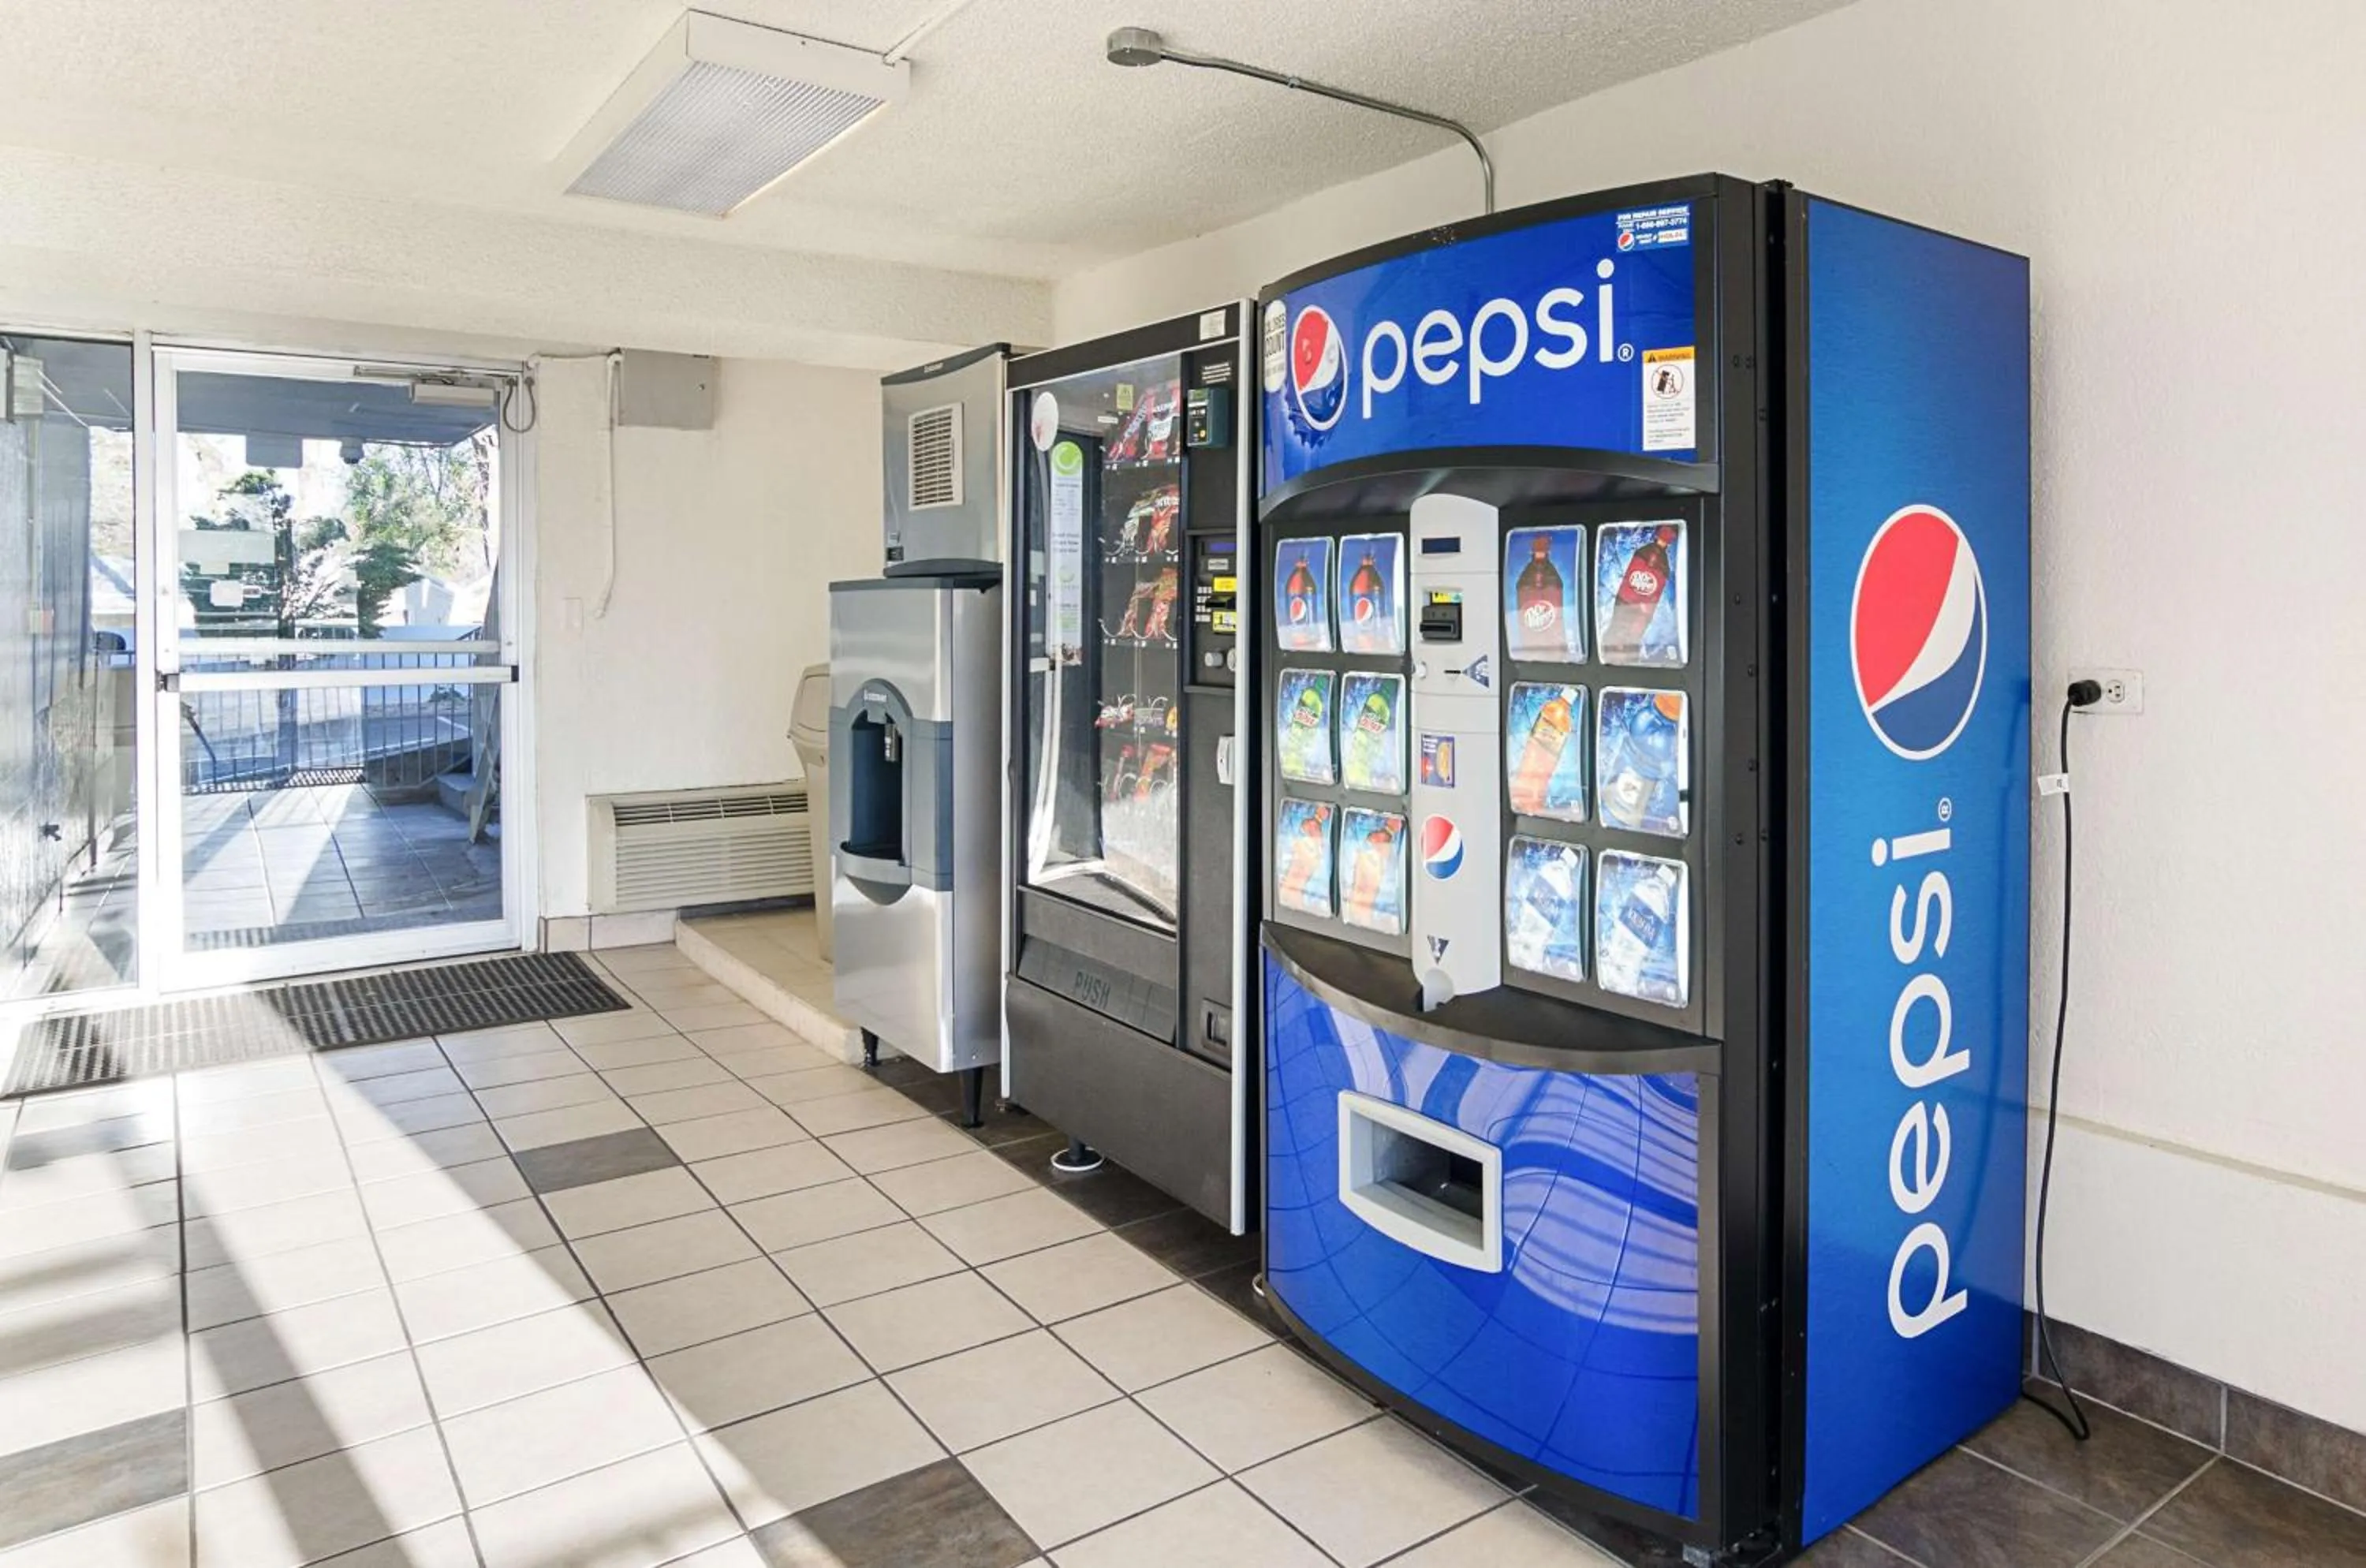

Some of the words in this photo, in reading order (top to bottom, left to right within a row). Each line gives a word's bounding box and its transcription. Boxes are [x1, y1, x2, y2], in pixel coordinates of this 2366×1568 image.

[1362, 259, 1614, 420] pepsi
[1074, 971, 1111, 1010] PUSH
[1872, 828, 1970, 1339] pepsi
